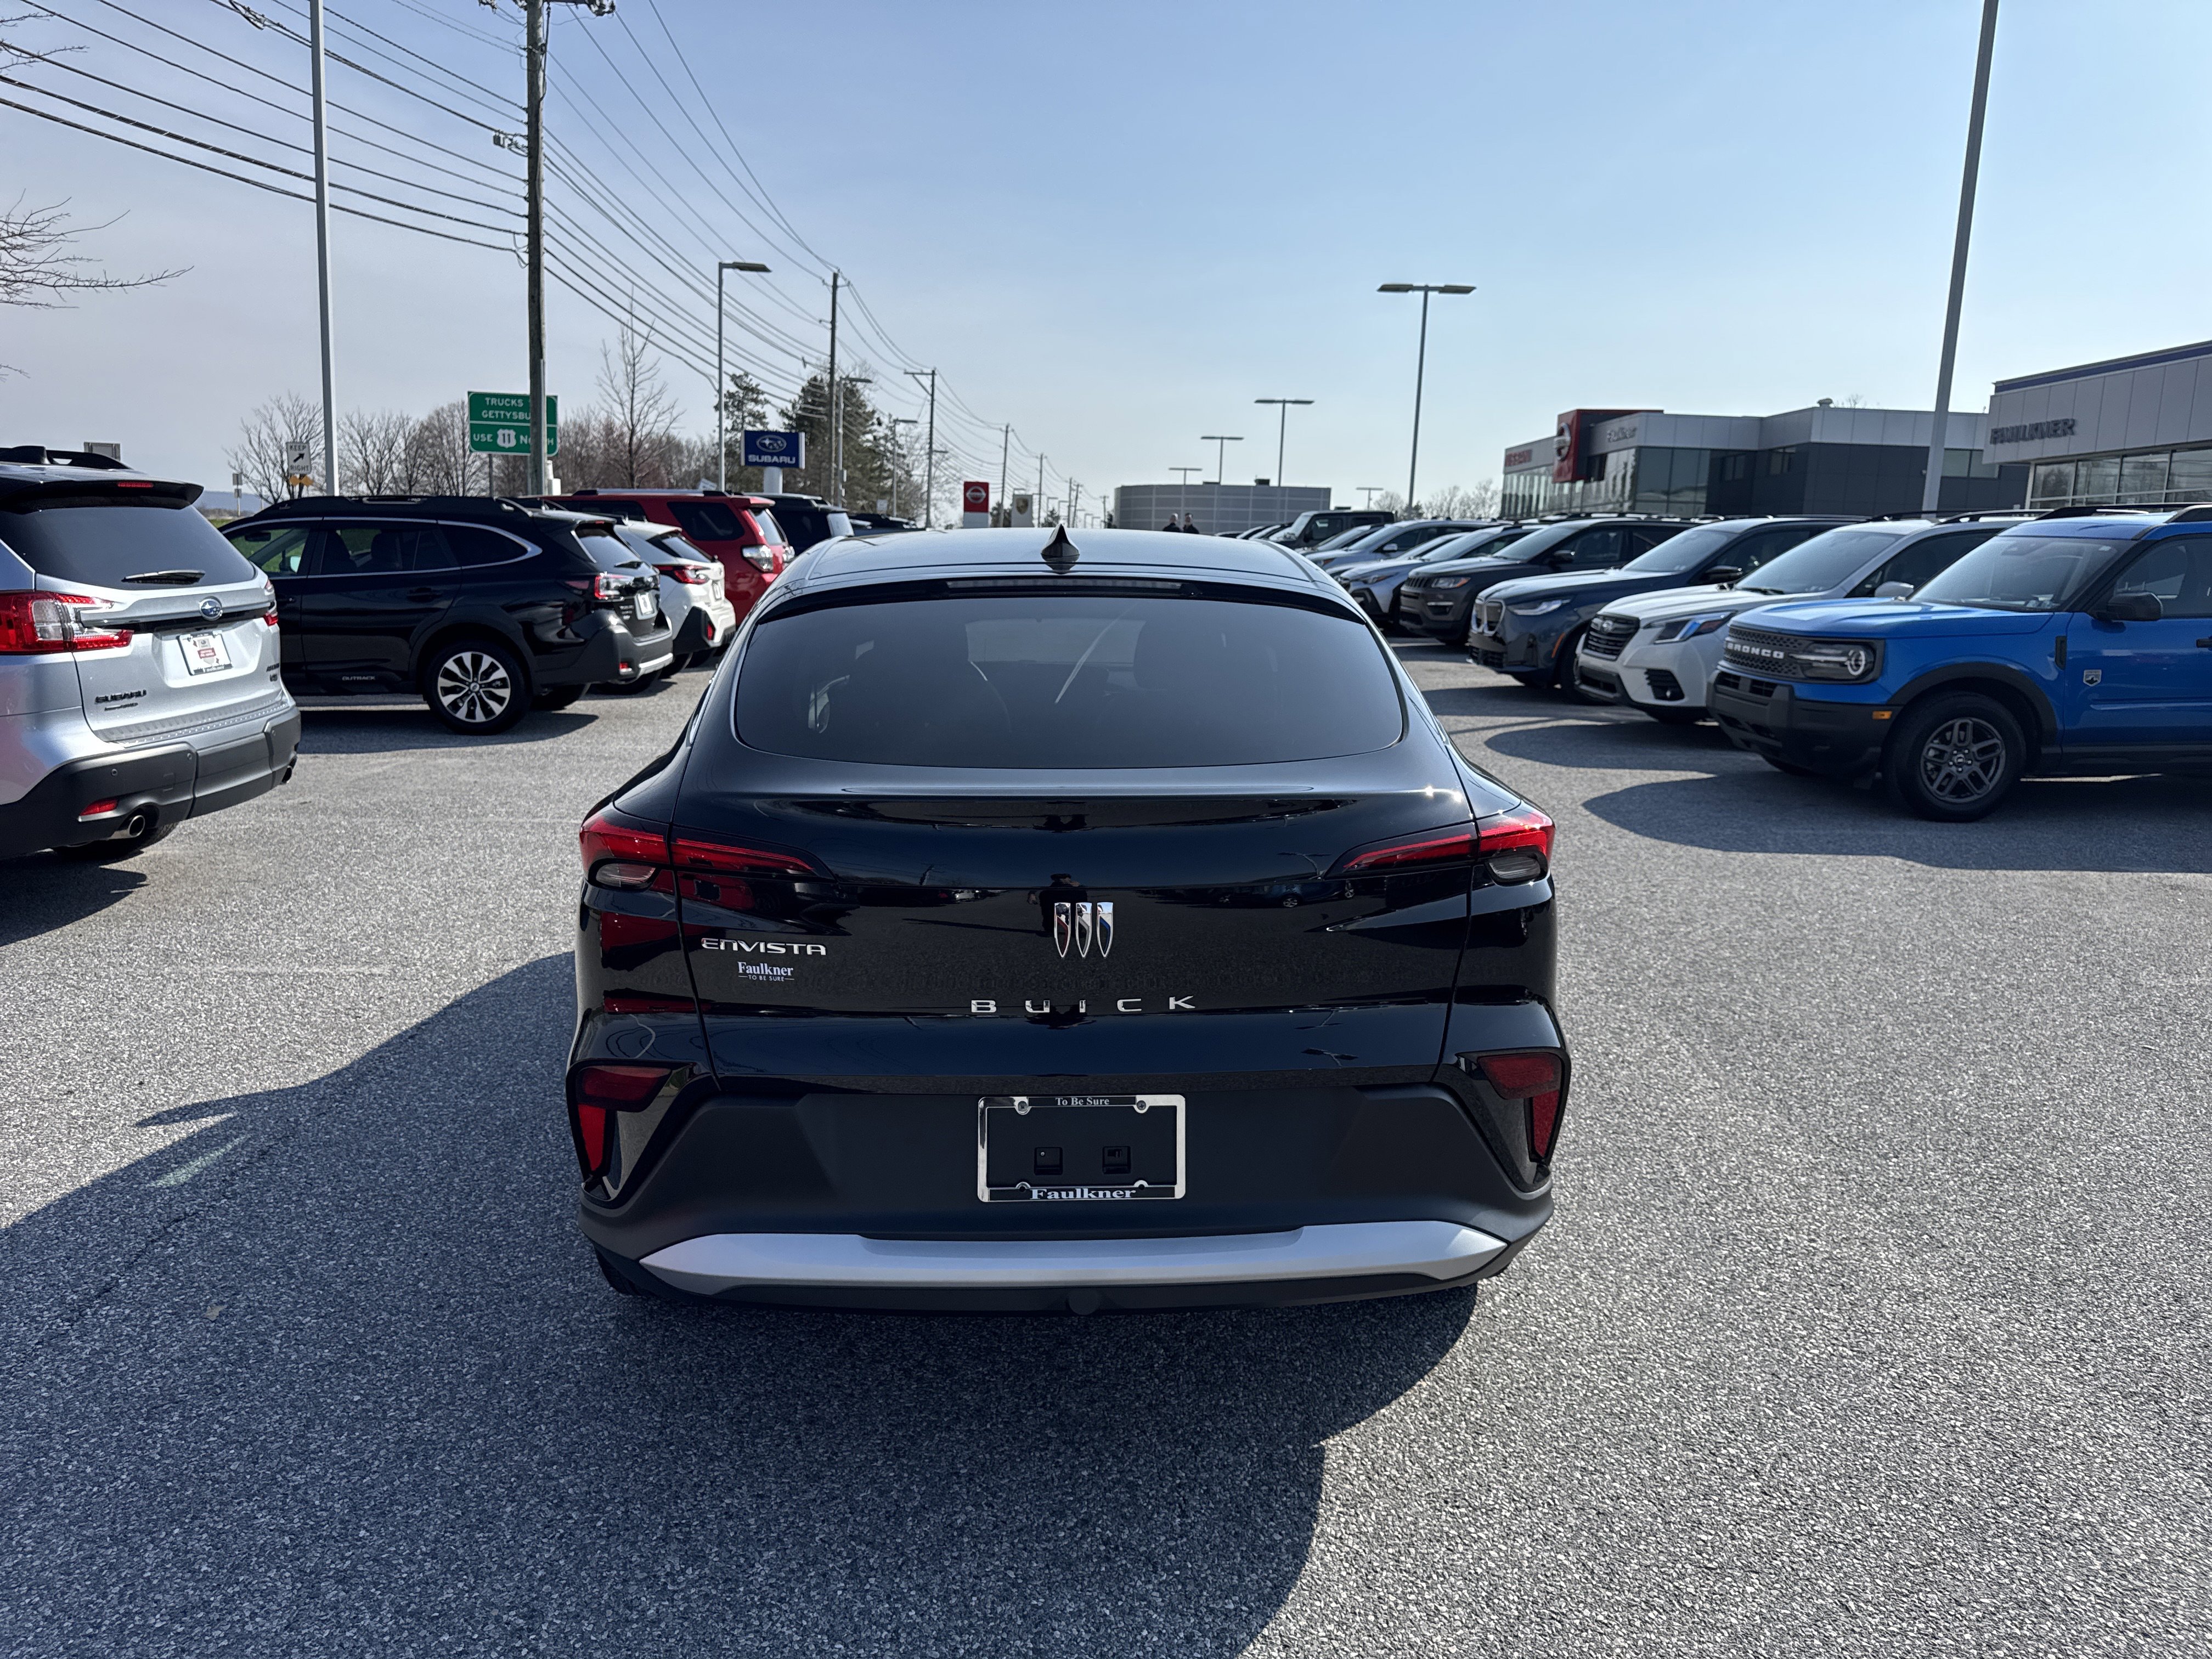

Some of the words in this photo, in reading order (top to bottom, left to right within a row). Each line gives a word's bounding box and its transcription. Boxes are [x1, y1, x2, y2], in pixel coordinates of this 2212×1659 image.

[485, 397, 524, 407] TRUCKS
[481, 410, 531, 420] GETTYSBU
[1990, 418, 2076, 444] FAULKNER
[473, 433, 493, 442] USE
[502, 433, 511, 444] 11
[748, 454, 796, 464] SUBARU
[1726, 642, 1785, 659] BRONCO
[95, 689, 147, 703] SUBARU
[701, 938, 826, 956] ENVISTA
[737, 961, 794, 977] Faulkner
[970, 995, 1196, 1013] BUICK
[1055, 1097, 1068, 1105] To
[1071, 1097, 1084, 1105] Be
[1086, 1096, 1110, 1105] Sure
[1030, 1188, 1137, 1200] Faulkner
